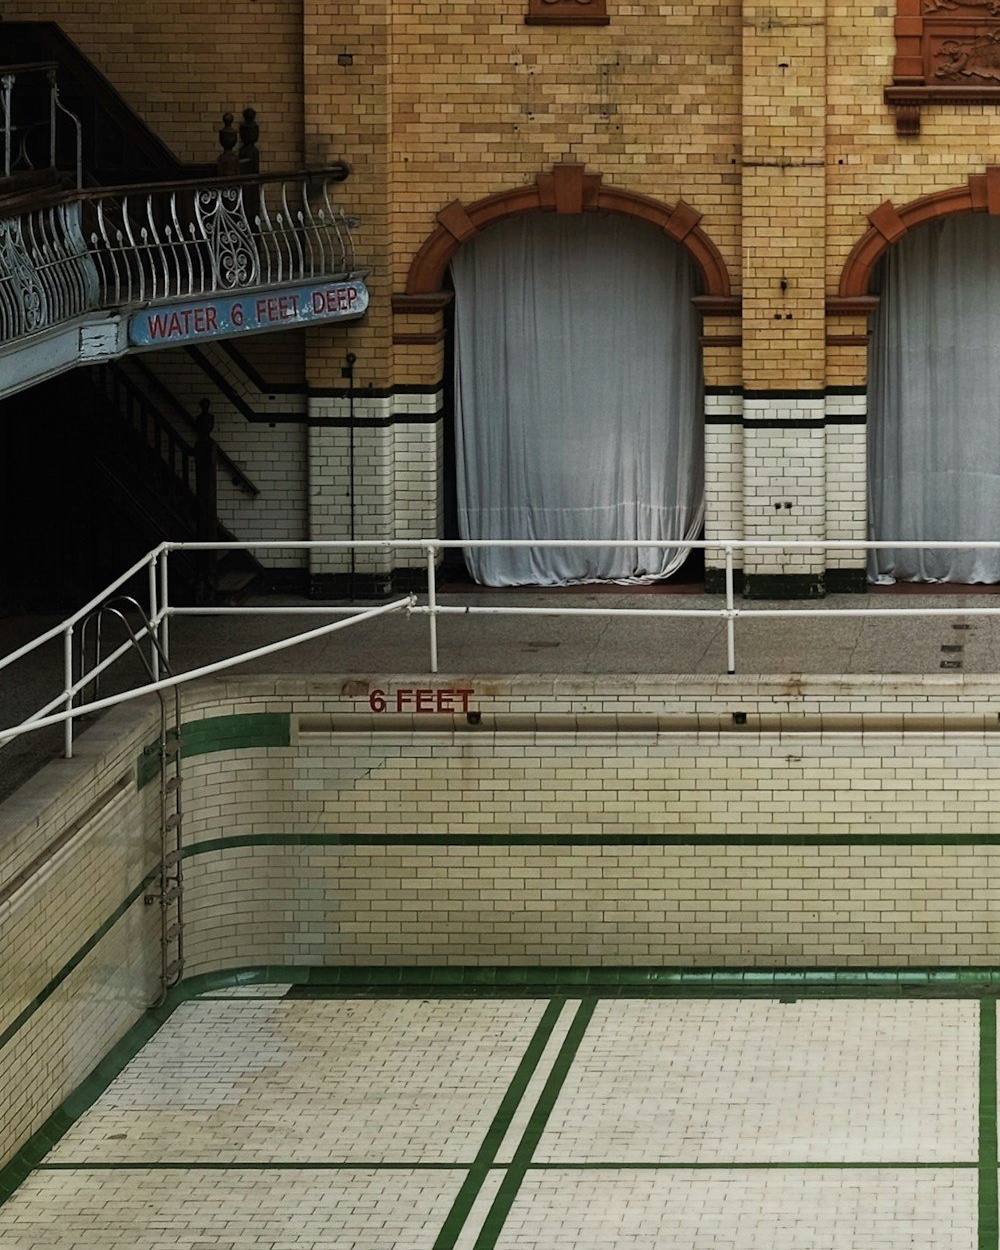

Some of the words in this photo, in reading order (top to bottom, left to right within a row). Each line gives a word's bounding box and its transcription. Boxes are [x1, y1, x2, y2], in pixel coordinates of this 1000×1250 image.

[146, 306, 218, 340] WATER
[230, 302, 244, 327] 6
[256, 294, 300, 323] FEET
[312, 287, 358, 315] DEEP
[369, 689, 387, 714] 6
[396, 689, 475, 714] FEET
